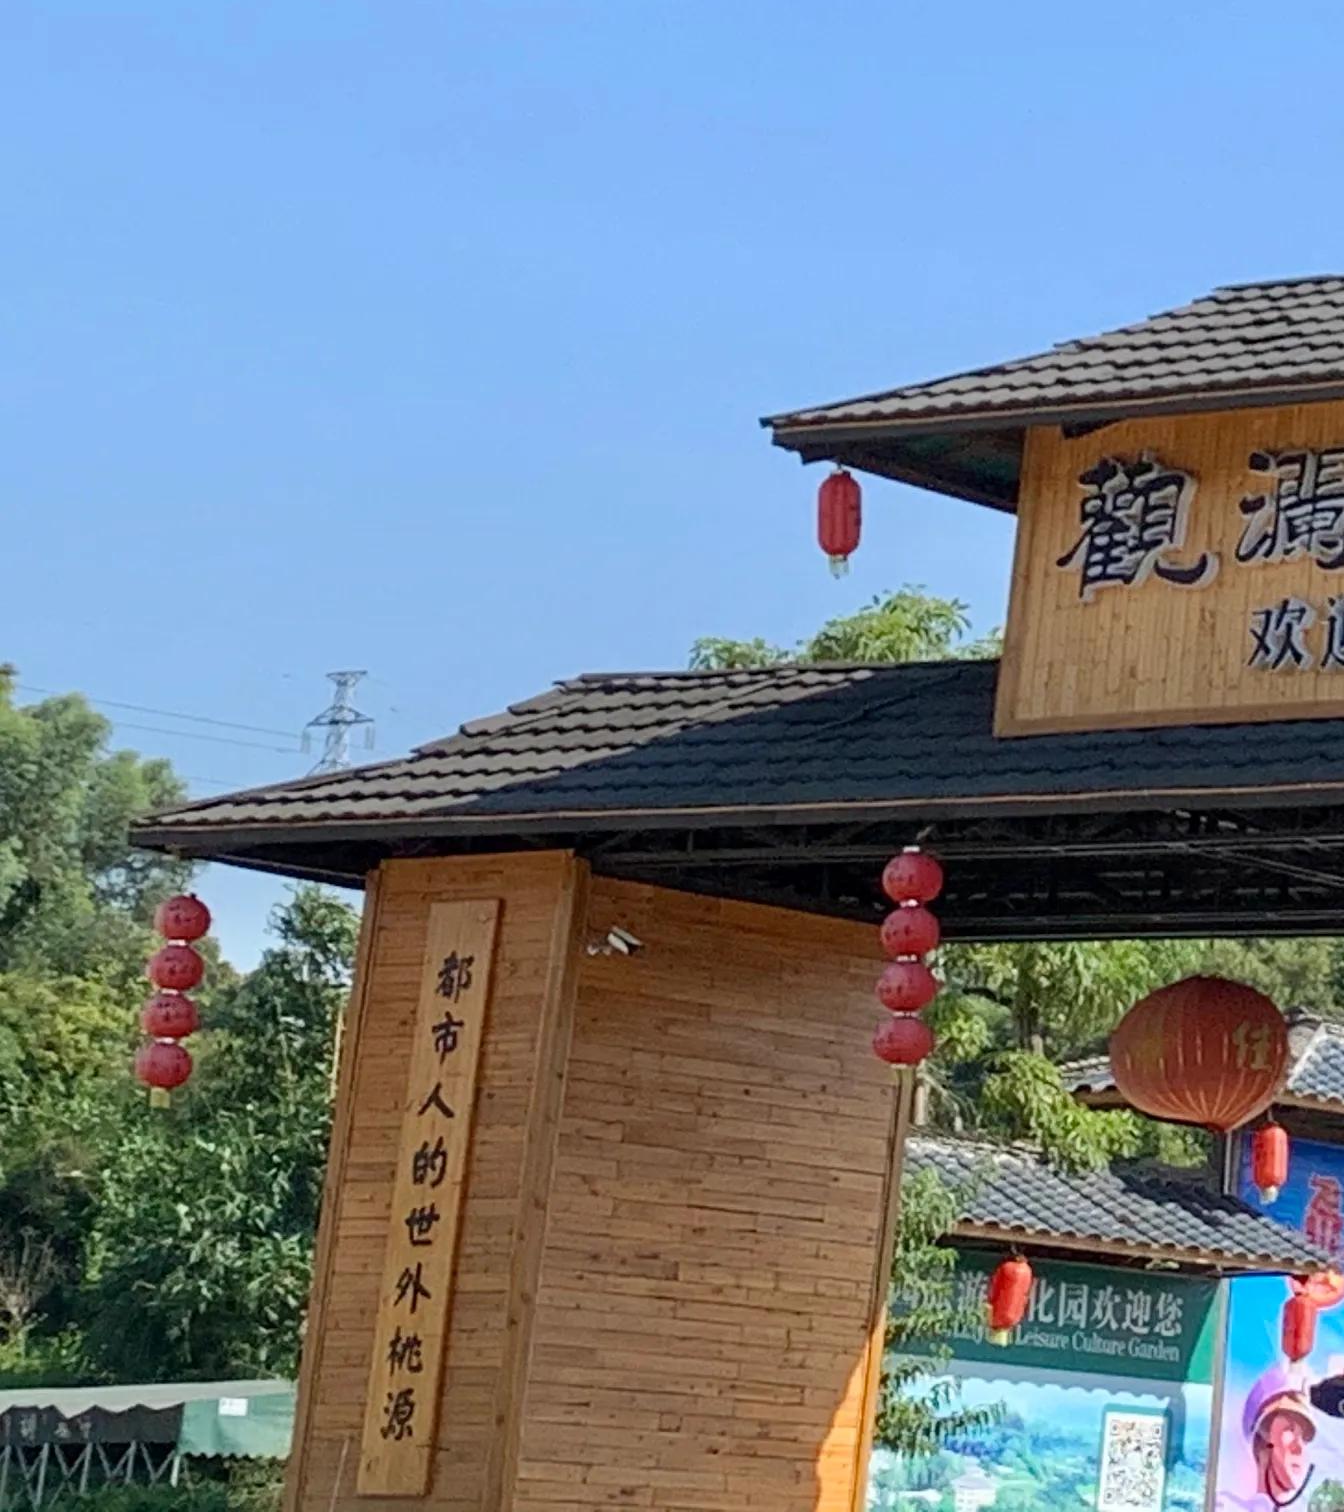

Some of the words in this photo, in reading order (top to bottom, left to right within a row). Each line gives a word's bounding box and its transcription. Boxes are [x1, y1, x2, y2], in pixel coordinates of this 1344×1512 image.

[381, 951, 476, 1439] 都市人的世外桃源
[1015, 1323, 1069, 1351] Leisure
[1072, 1330, 1126, 1357] Culture
[1129, 1335, 1180, 1363] Garden
